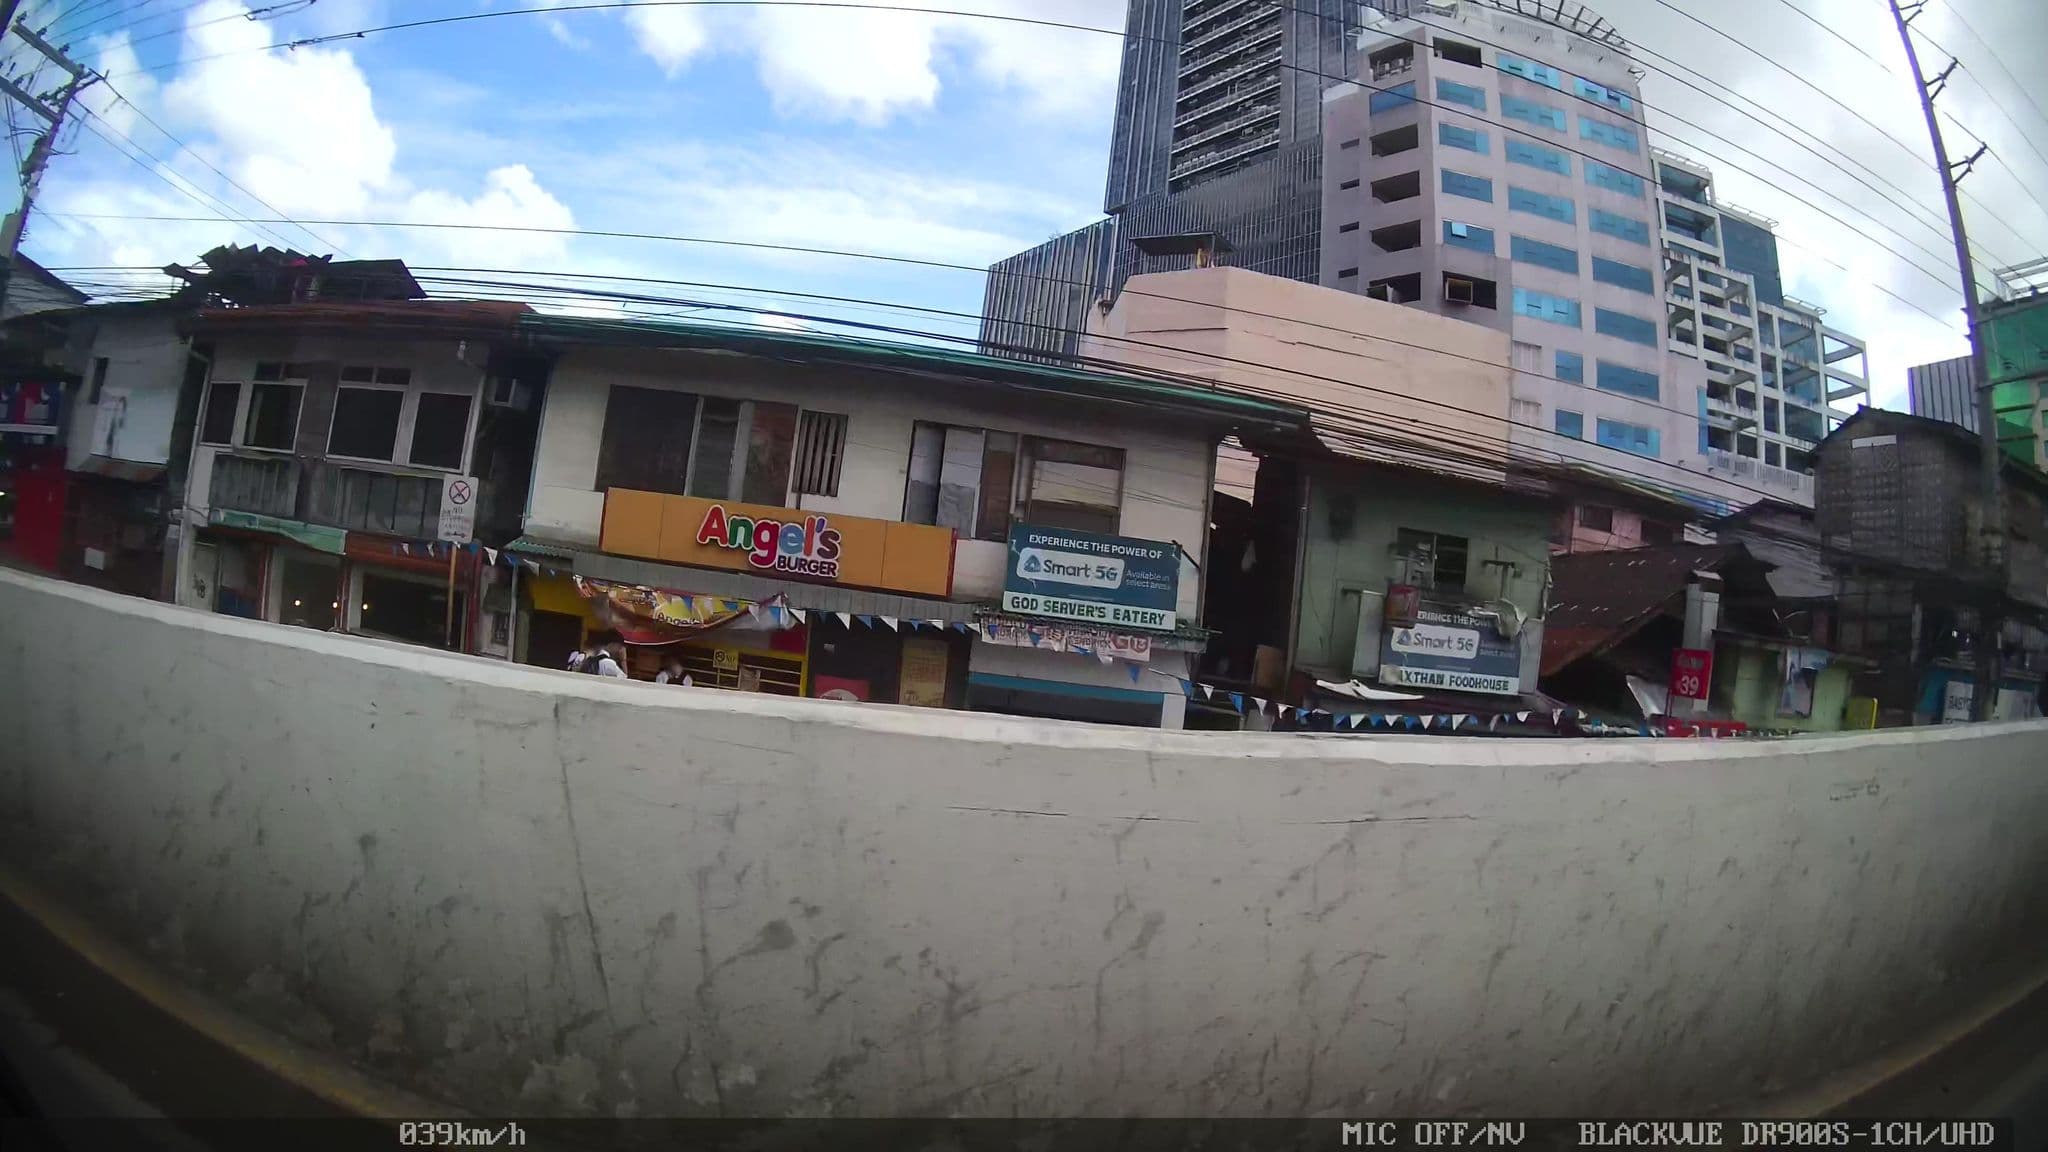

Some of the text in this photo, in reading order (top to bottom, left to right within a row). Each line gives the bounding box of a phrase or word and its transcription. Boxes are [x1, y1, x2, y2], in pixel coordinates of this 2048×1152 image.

[697, 504, 841, 567] Angel's
[1029, 534, 1164, 560] EXPERIENCE THE POWER OF
[776, 554, 838, 577] BURGER
[1043, 559, 1119, 582] Smart 5G
[1011, 596, 1166, 626] GOD SERVER'S EATERY
[1453, 614, 1469, 625] THE
[1413, 632, 1452, 650] Smart
[1450, 675, 1510, 691] FOODHOUSE
[1680, 675, 1700, 696] 39
